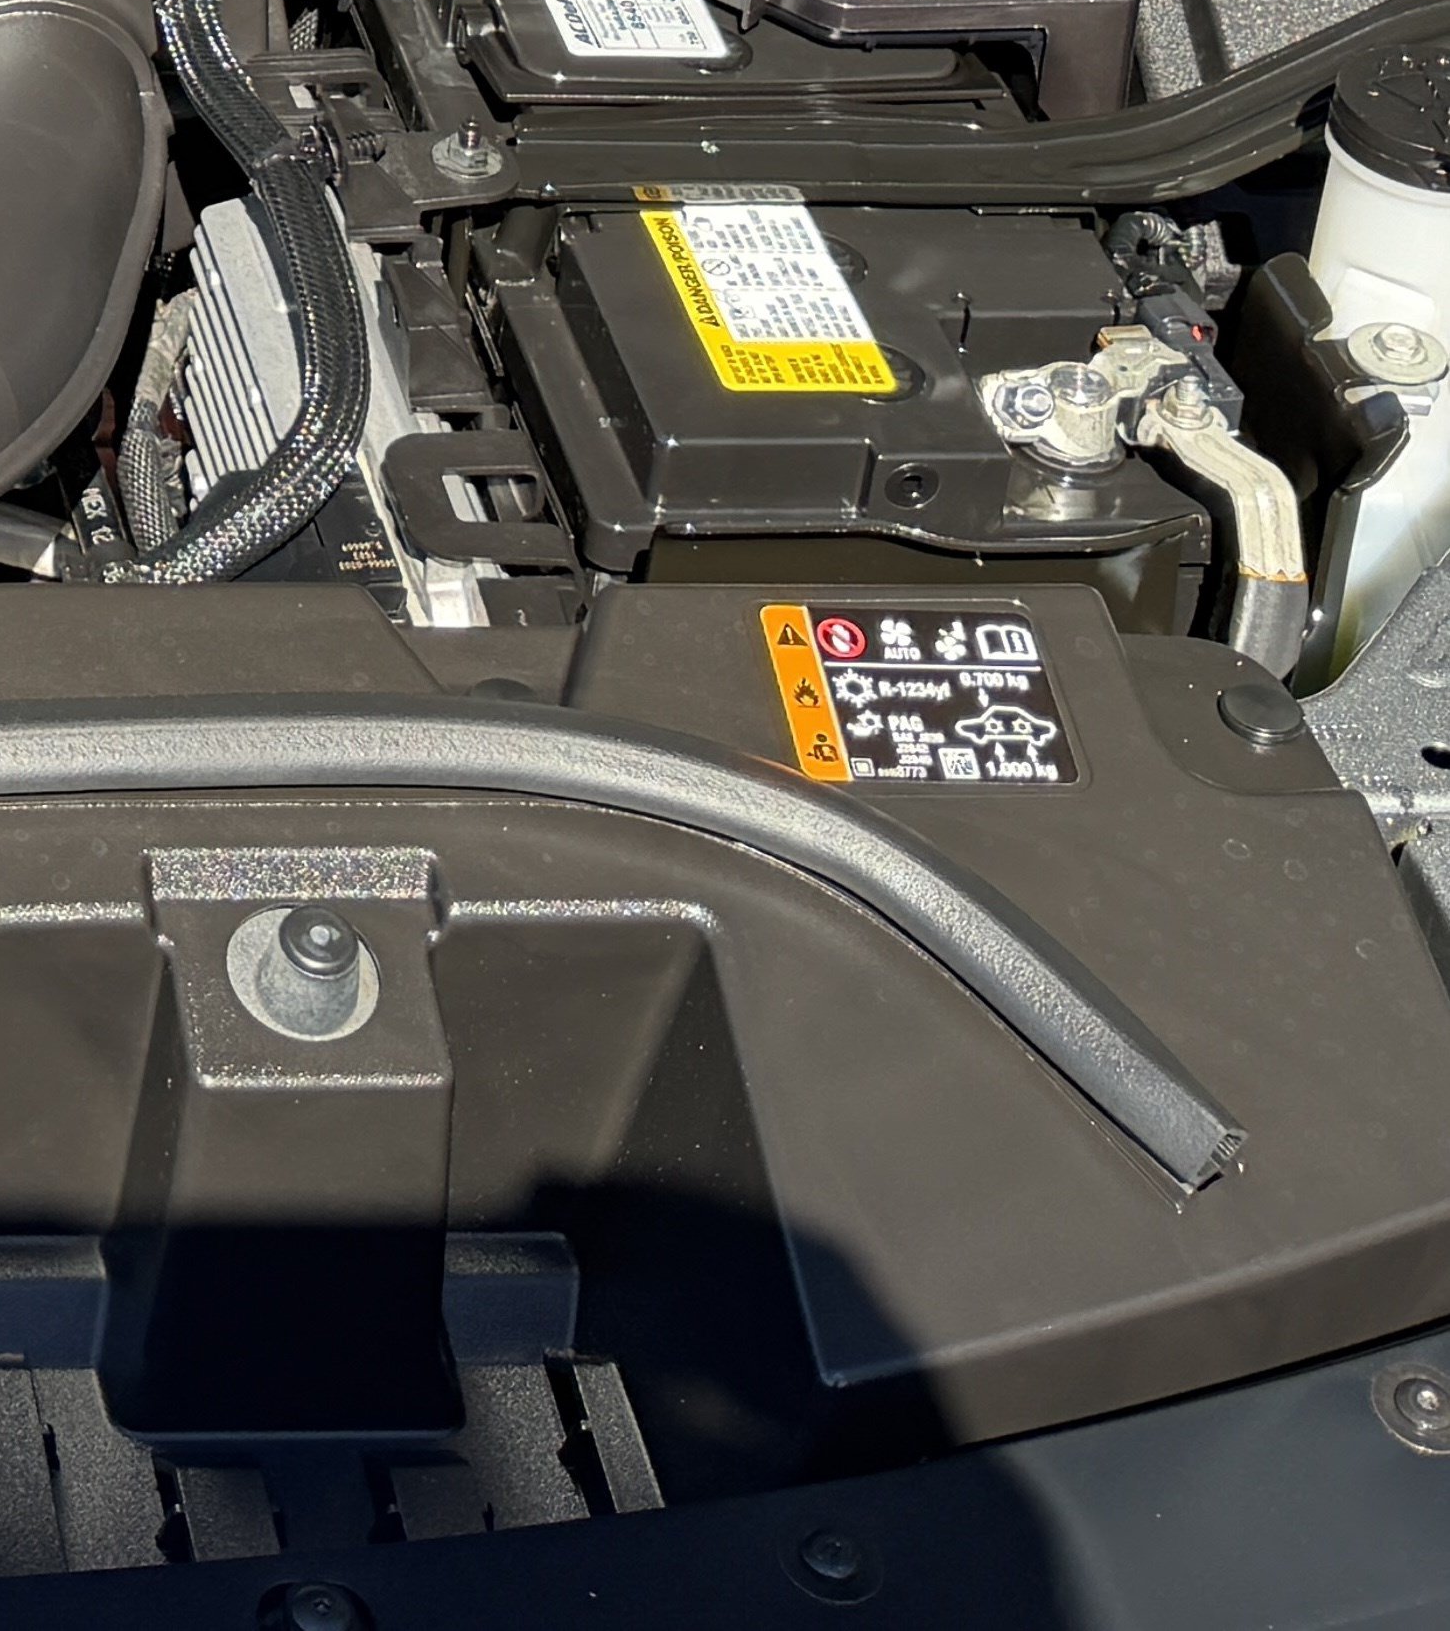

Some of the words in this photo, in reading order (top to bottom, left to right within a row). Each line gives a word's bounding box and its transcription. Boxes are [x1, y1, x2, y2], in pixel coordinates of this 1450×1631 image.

[883, 646, 921, 660] AUTO
[1006, 672, 1030, 691] kg
[887, 714, 925, 733] PAG
[1036, 761, 1059, 780] kg
